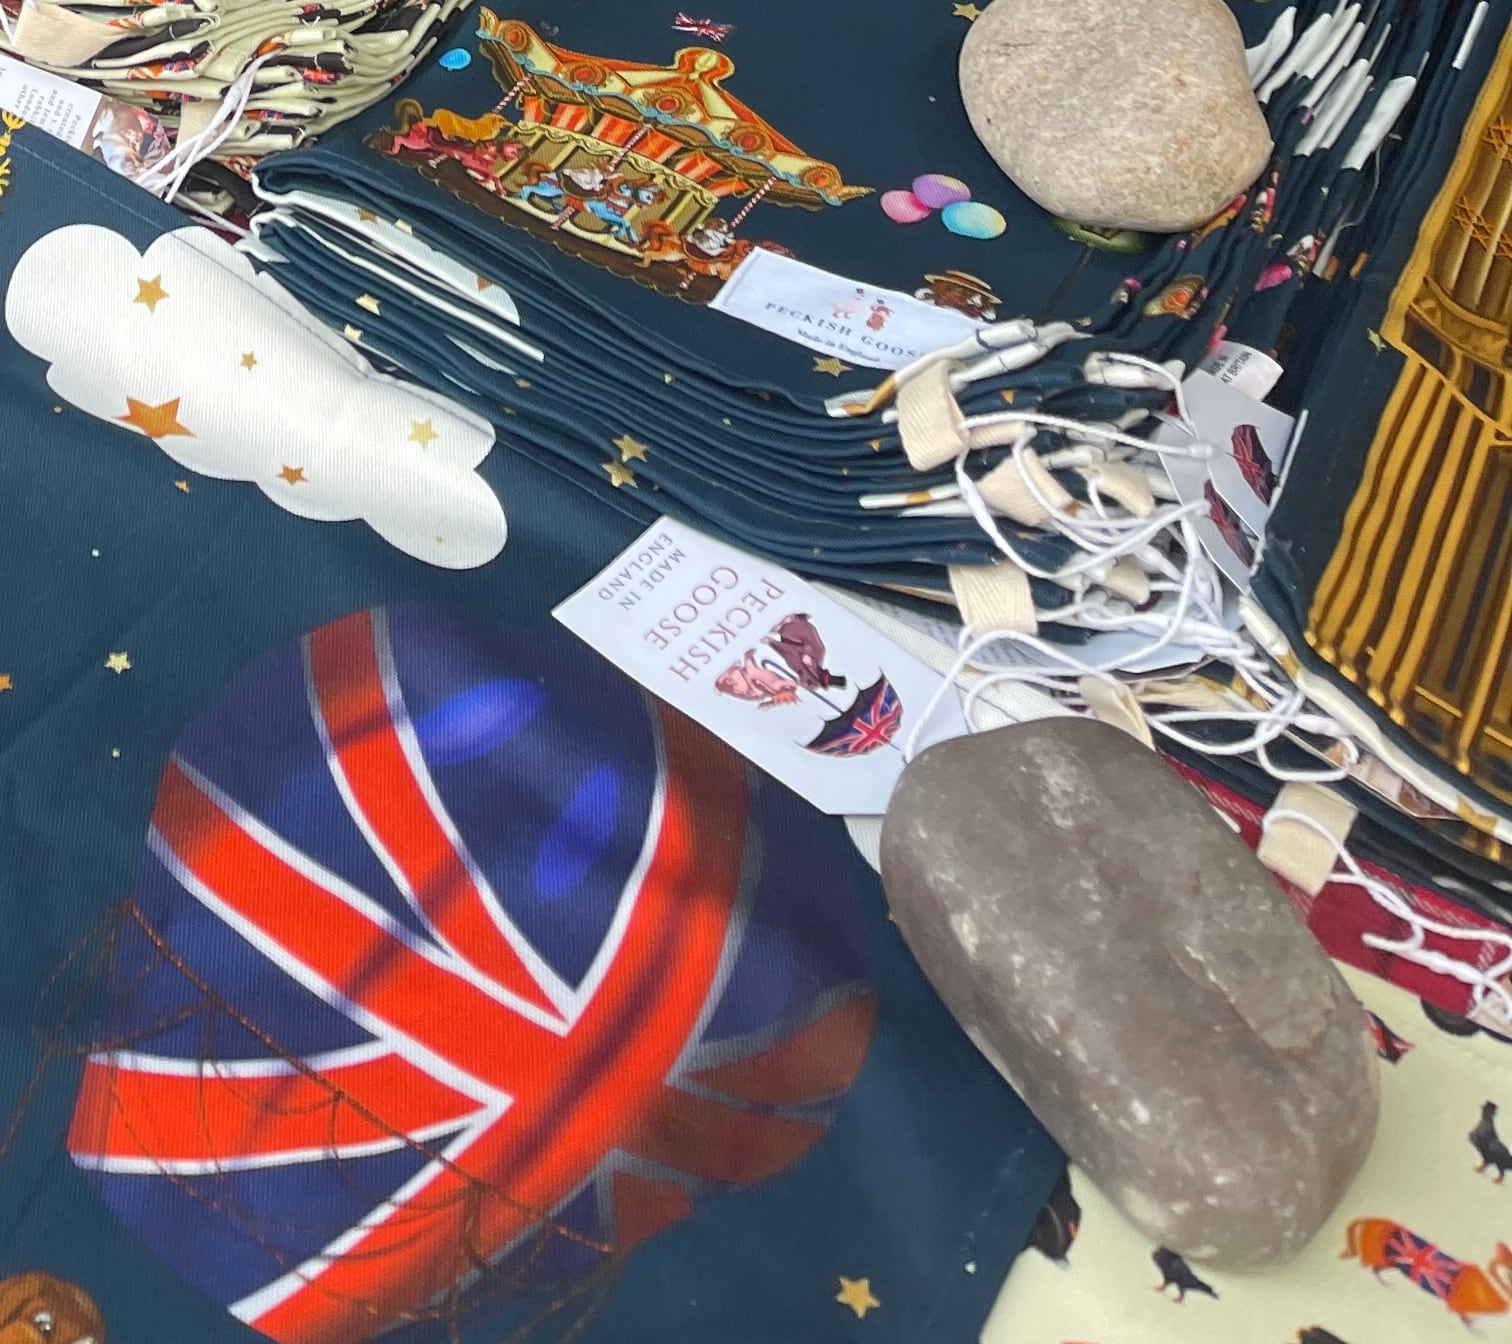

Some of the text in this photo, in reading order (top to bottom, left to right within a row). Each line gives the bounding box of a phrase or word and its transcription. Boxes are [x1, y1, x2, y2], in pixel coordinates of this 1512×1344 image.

[765, 302, 922, 358] PECKISH GOOS
[597, 531, 674, 601] ENGLAND
[618, 548, 687, 612] MADE IN
[643, 566, 740, 651] GOOSE
[669, 577, 786, 682] PECKISH
